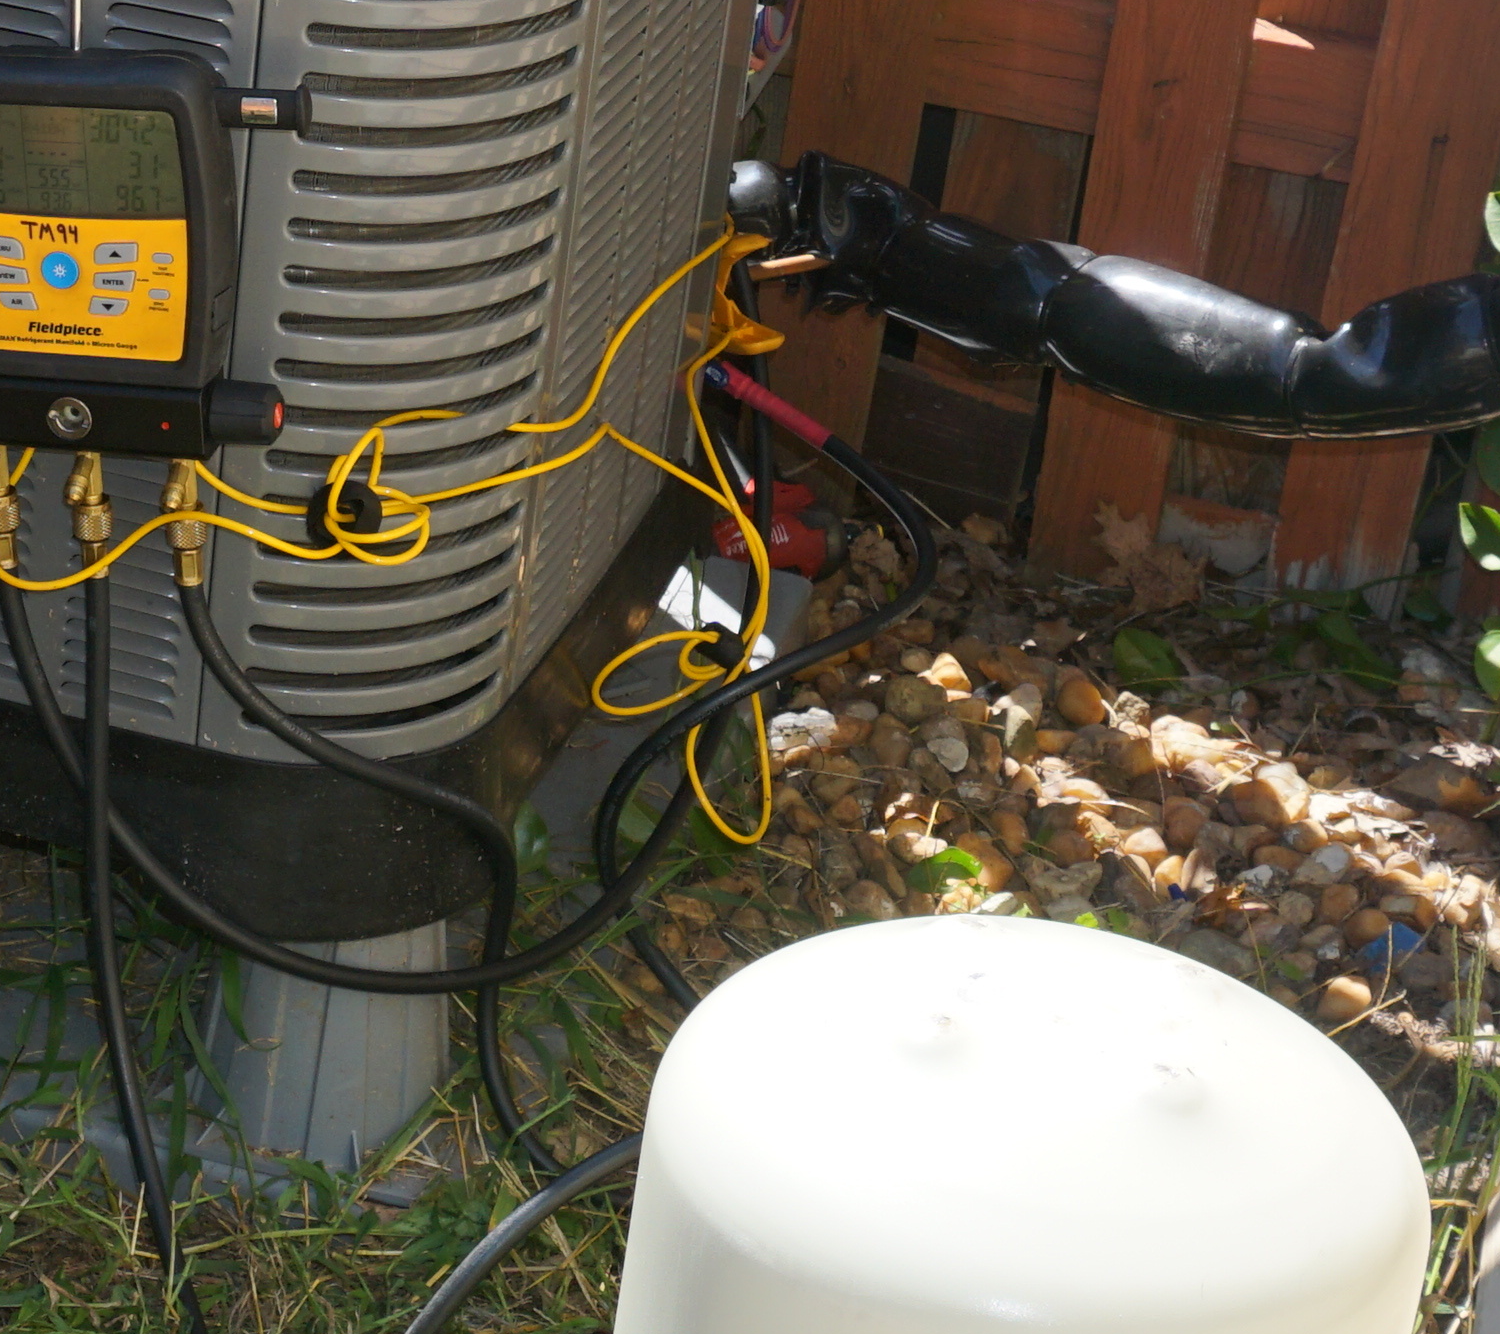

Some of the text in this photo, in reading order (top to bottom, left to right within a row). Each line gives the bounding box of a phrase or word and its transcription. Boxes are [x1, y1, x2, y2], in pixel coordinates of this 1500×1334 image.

[20, 220, 79, 244] TM94
[101, 278, 125, 287] ENTER
[10, 298, 23, 306] AIR
[28, 321, 103, 336] Fieldpiece
[16, 335, 55, 345] Refrigerant
[55, 338, 85, 346] Manifold
